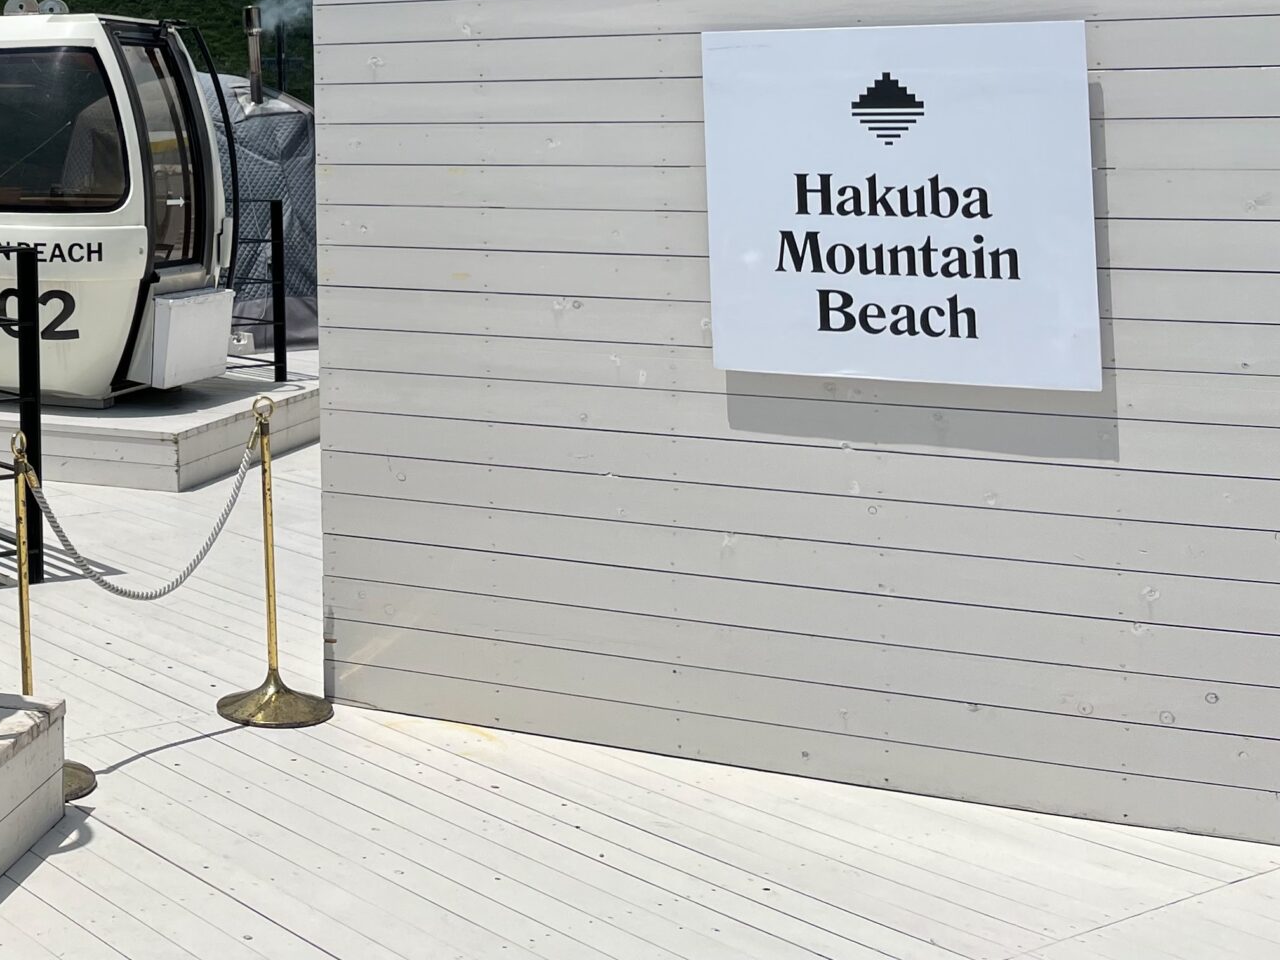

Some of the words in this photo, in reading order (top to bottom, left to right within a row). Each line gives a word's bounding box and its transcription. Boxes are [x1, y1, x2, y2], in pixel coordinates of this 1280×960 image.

[794, 173, 992, 219] Hakuba
[775, 230, 1020, 279] Mountain
[816, 289, 978, 339] Beach
